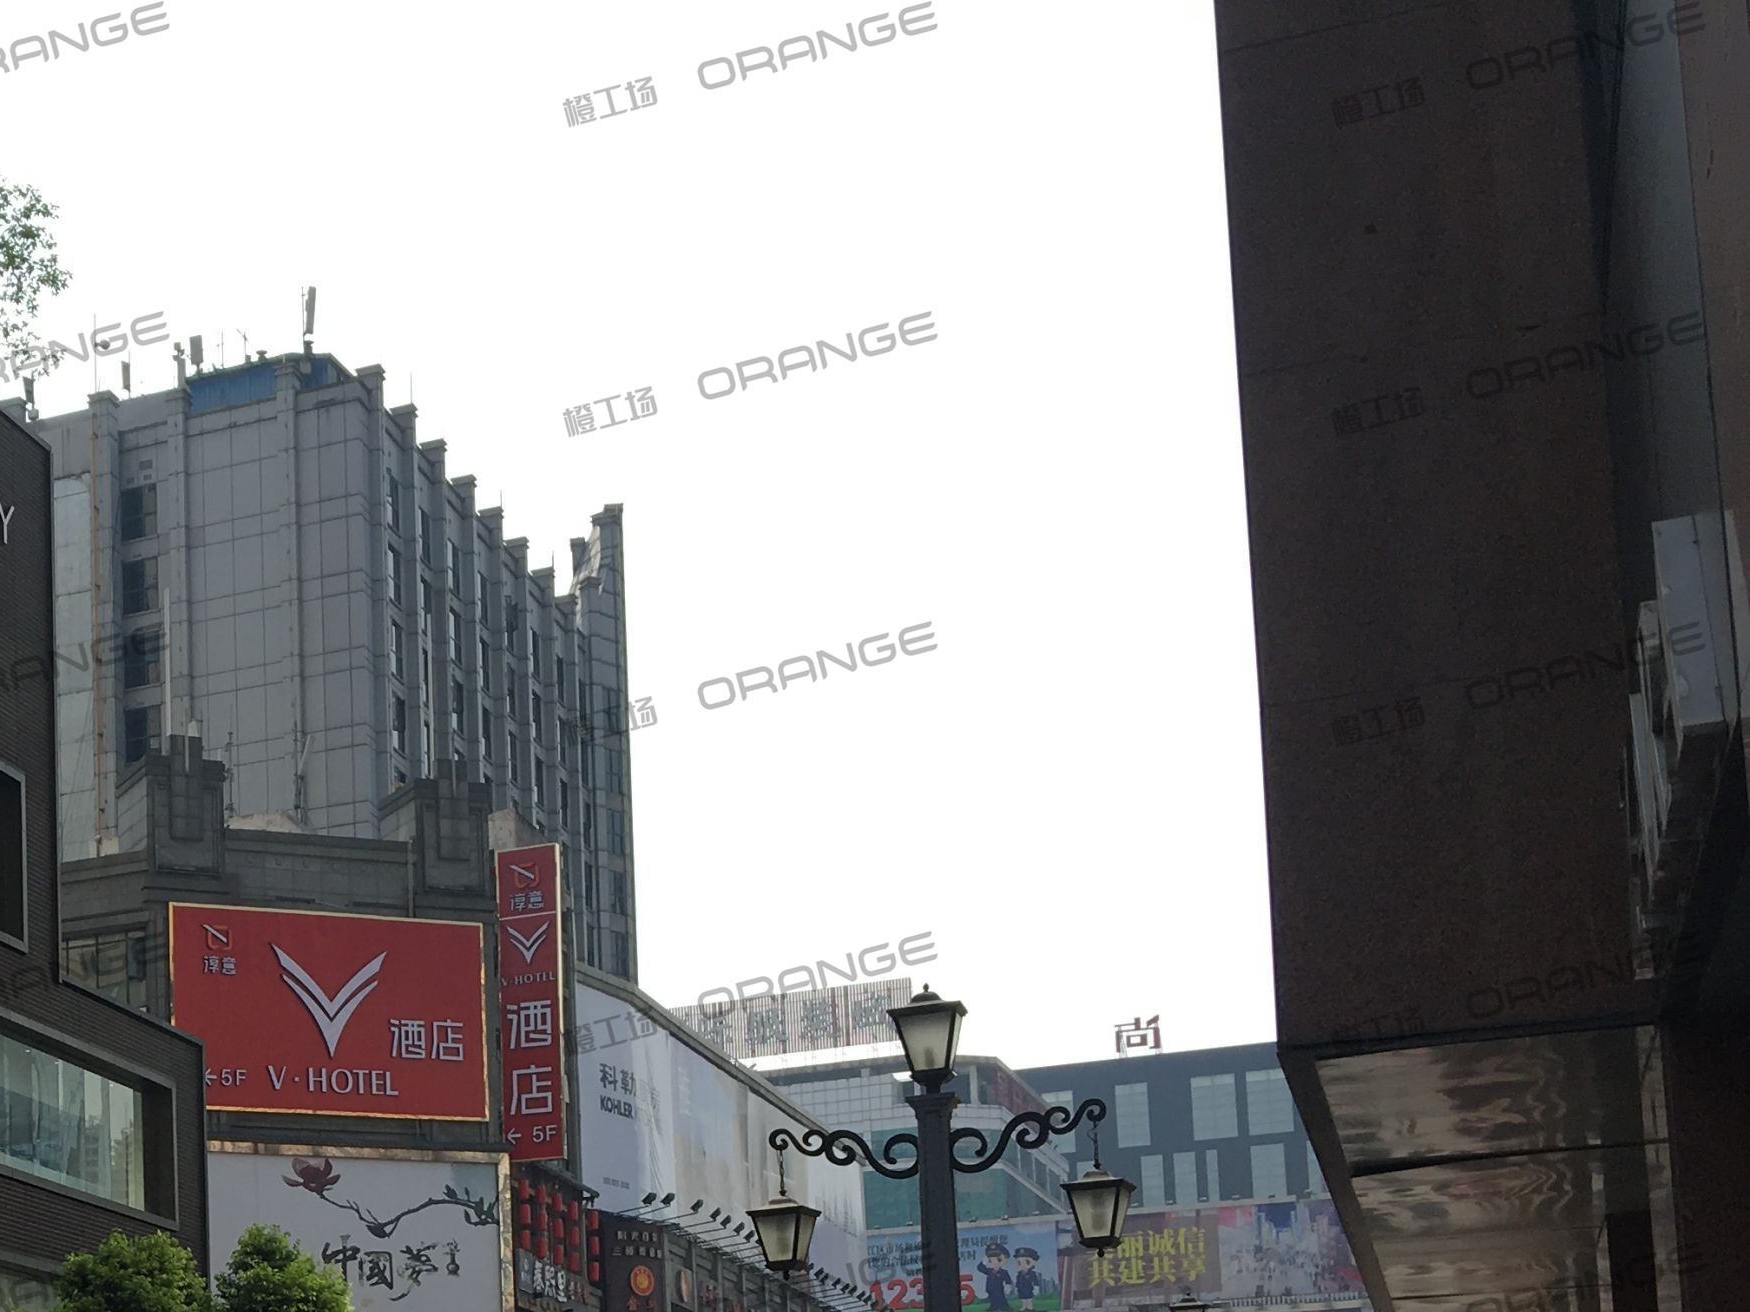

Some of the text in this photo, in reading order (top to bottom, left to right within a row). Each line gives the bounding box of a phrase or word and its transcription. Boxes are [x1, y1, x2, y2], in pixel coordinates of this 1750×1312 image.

[387, 1017, 464, 1062] 酒店
[506, 999, 553, 1116] 酒店
[221, 1068, 248, 1087] 5F
[599, 1095, 635, 1120] KOHLER
[533, 1125, 558, 1144] 5F
[1087, 1256, 1207, 1288] 共建共享
[869, 1273, 976, 1311] 1235
